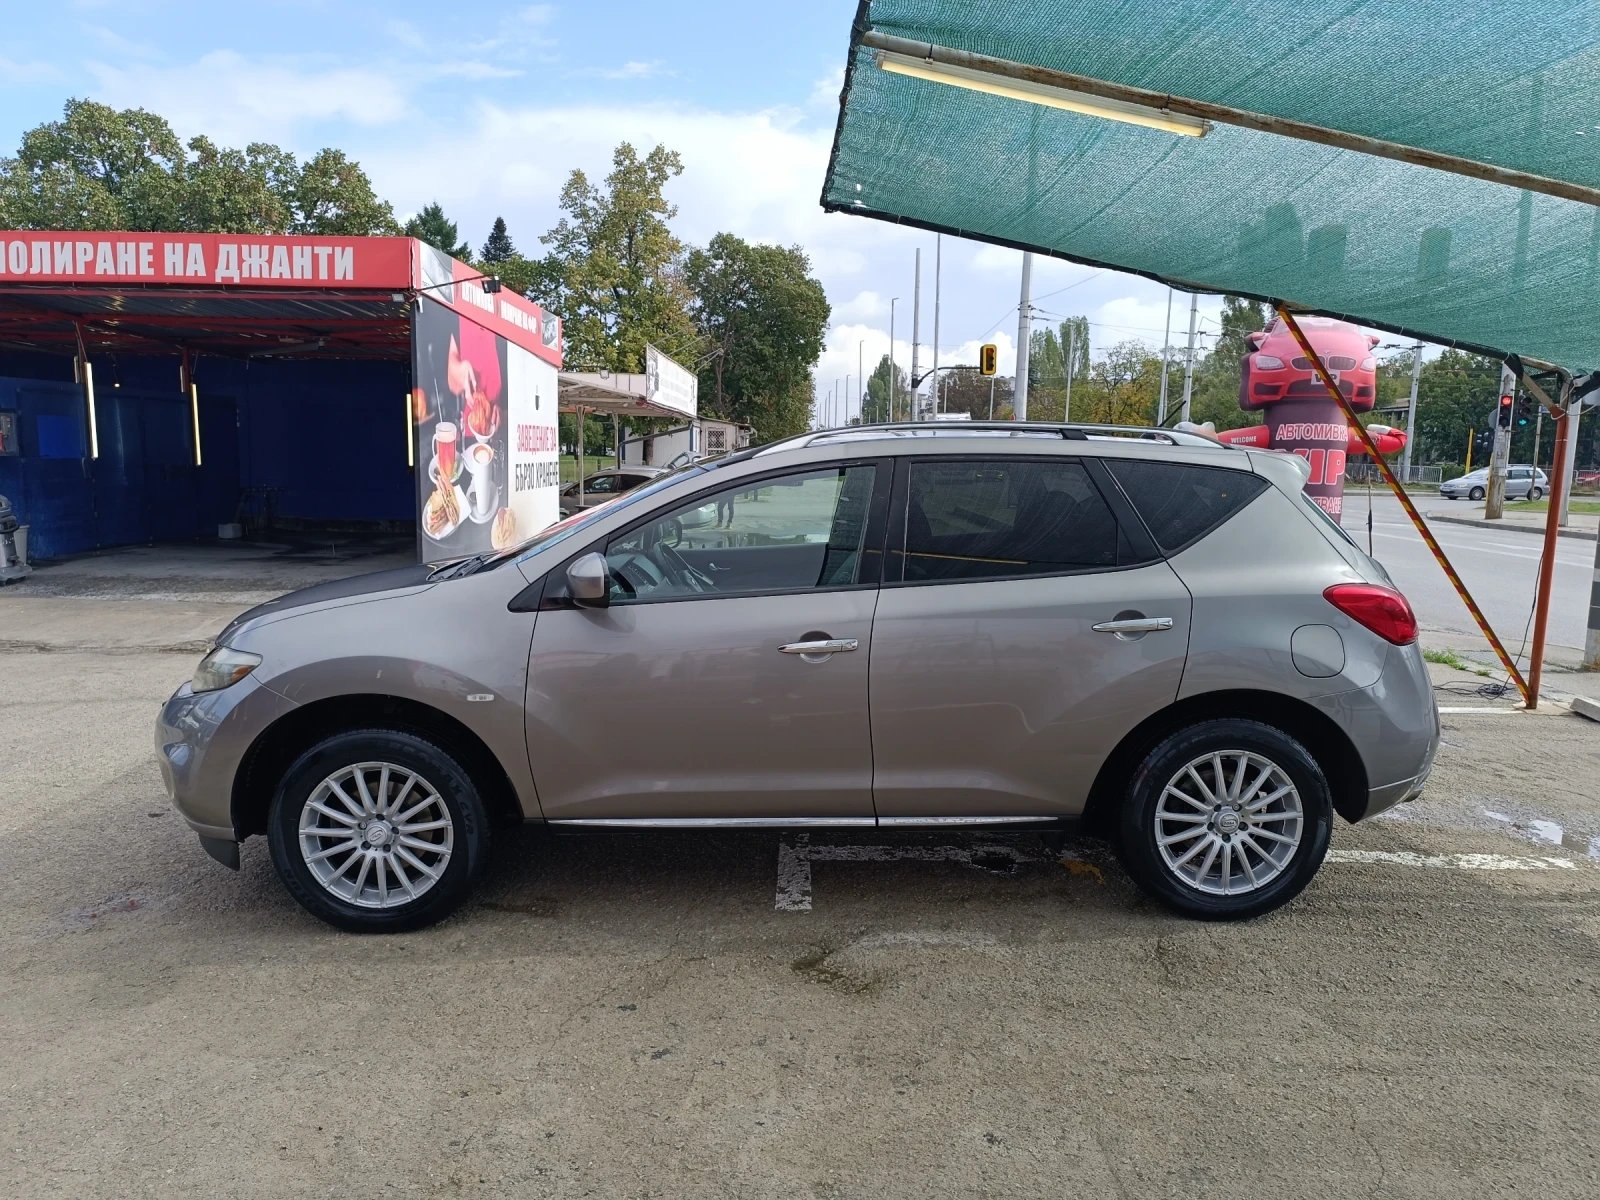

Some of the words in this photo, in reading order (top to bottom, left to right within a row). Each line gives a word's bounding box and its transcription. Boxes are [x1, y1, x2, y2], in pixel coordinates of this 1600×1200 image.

[164, 242, 206, 277] НА
[215, 243, 354, 283] ДЖАНТИ
[1314, 373, 1338, 383] VP
[516, 424, 549, 455] ЗАВЕДЕНИЕ
[550, 426, 557, 452] ЗА
[1230, 435, 1257, 444] WELCOME
[1275, 422, 1349, 442] АВТОМИВКА
[515, 462, 535, 492] БЪРЗО
[535, 461, 559, 489] ХРАНЕНЕ
